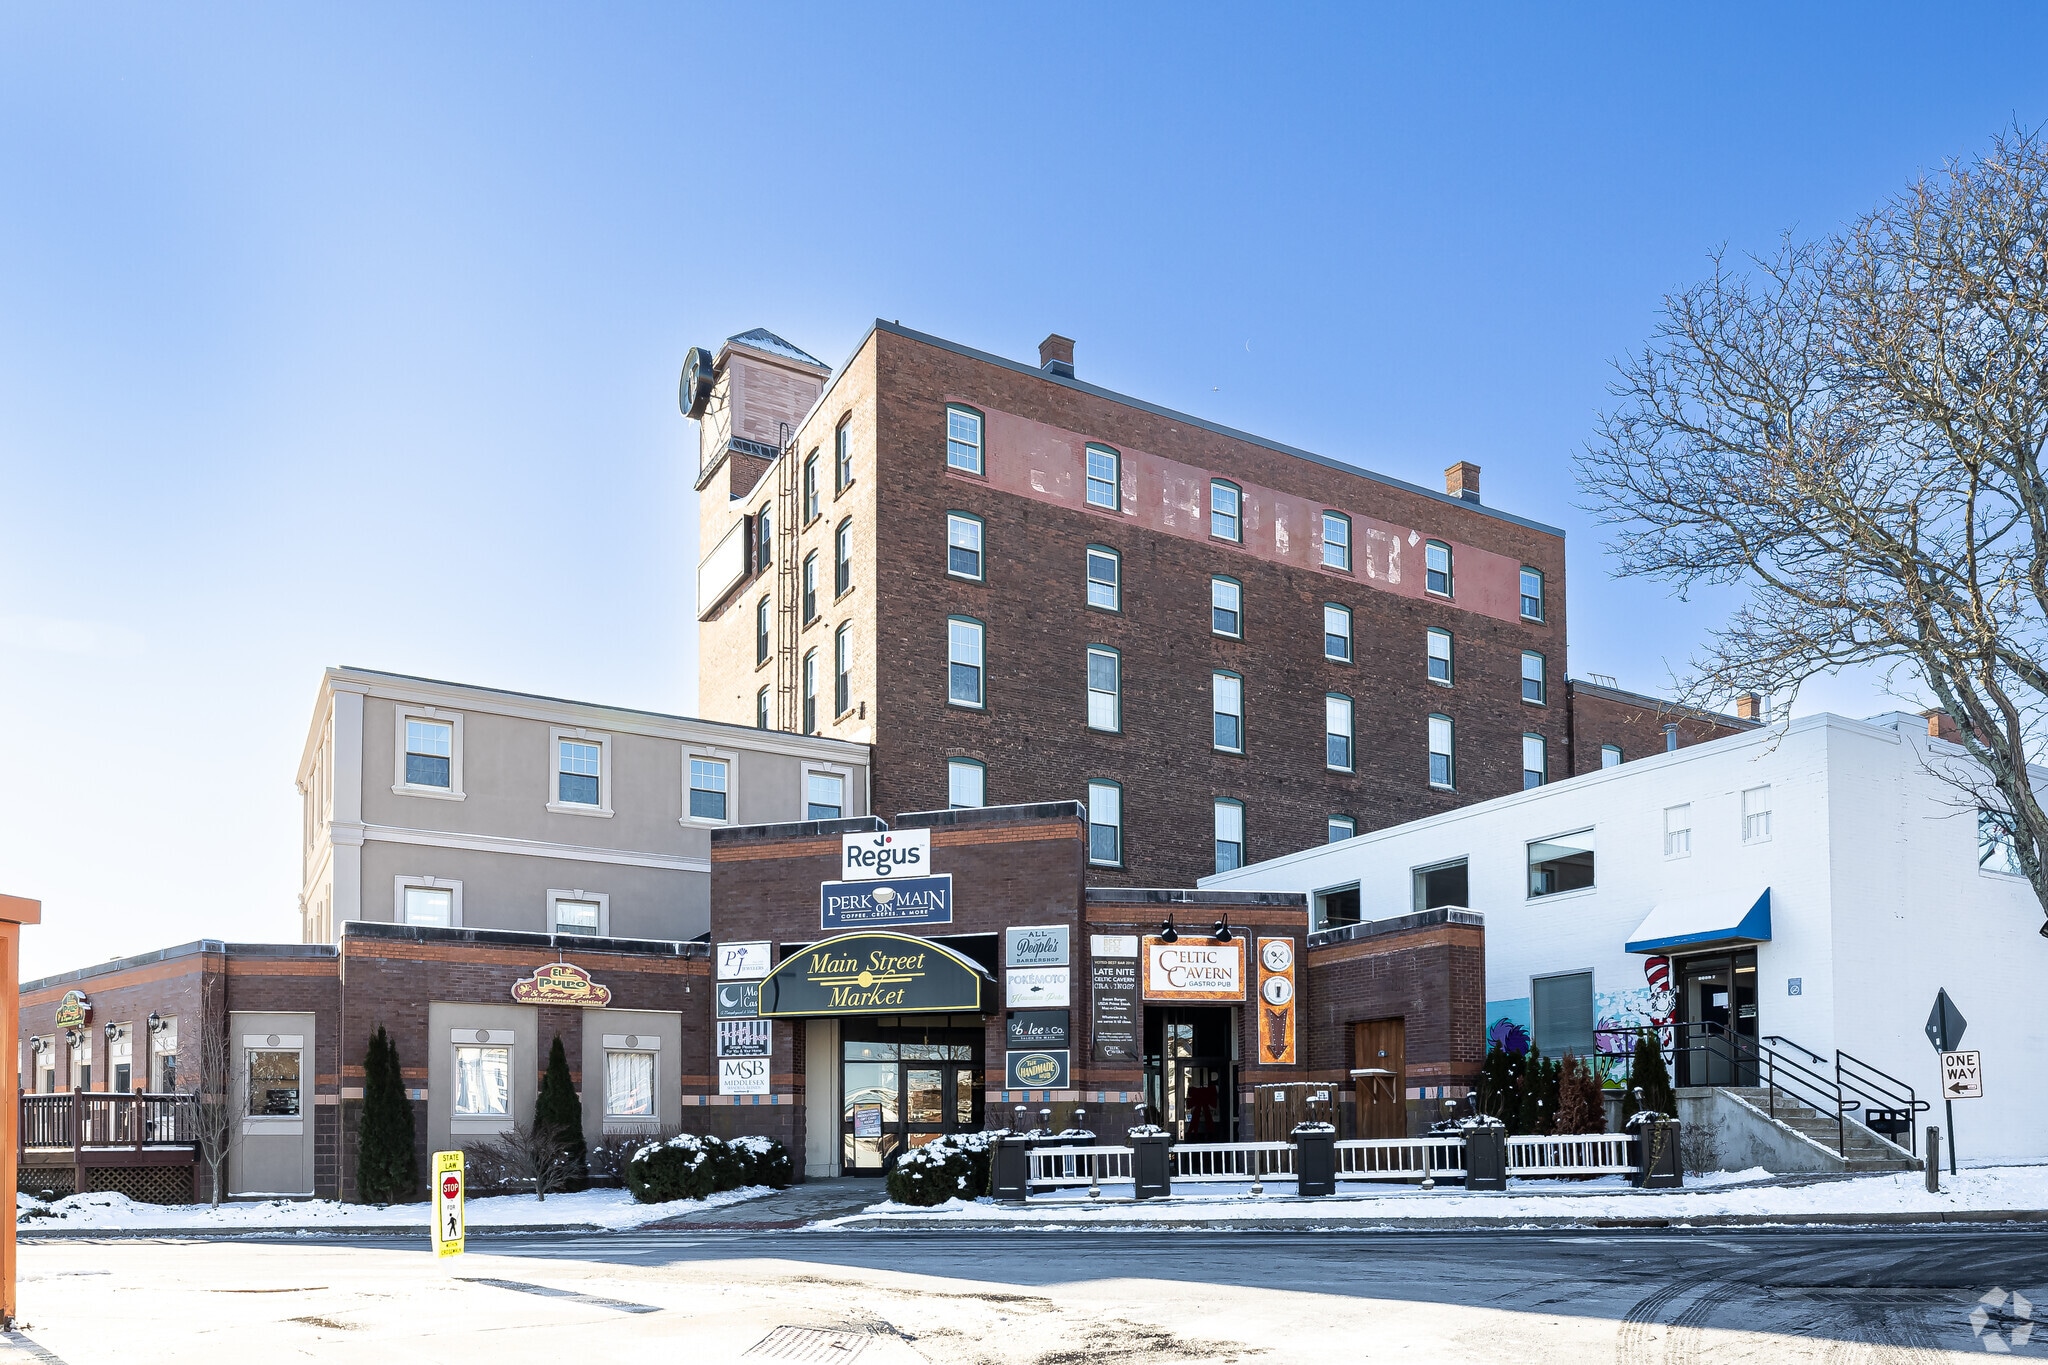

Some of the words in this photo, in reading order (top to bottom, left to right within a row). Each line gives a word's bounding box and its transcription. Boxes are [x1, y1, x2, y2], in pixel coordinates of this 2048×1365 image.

[847, 845, 920, 876] Regus
[828, 894, 872, 916] PERK
[876, 903, 893, 913] ON
[896, 890, 946, 910] MAIN
[1016, 937, 1059, 958] People's
[807, 952, 858, 974] Main
[866, 950, 926, 972] Street
[1159, 950, 1217, 972] CELTIC
[552, 968, 568, 977] EL
[1094, 968, 1113, 976] LATE
[1115, 968, 1135, 976] NITE
[1167, 966, 1232, 987] CAVERN
[530, 989, 538, 997] &
[539, 989, 568, 998] Tapas
[570, 991, 595, 999] Bar
[828, 970, 905, 1008] Market
[1051, 1026, 1064, 1034] Co.
[725, 1060, 764, 1079] MSB
[1020, 1060, 1055, 1078] HANDMADE
[1946, 1054, 1975, 1067] ONE
[1947, 1068, 1976, 1080] WAY
[443, 1183, 459, 1193] STOP
